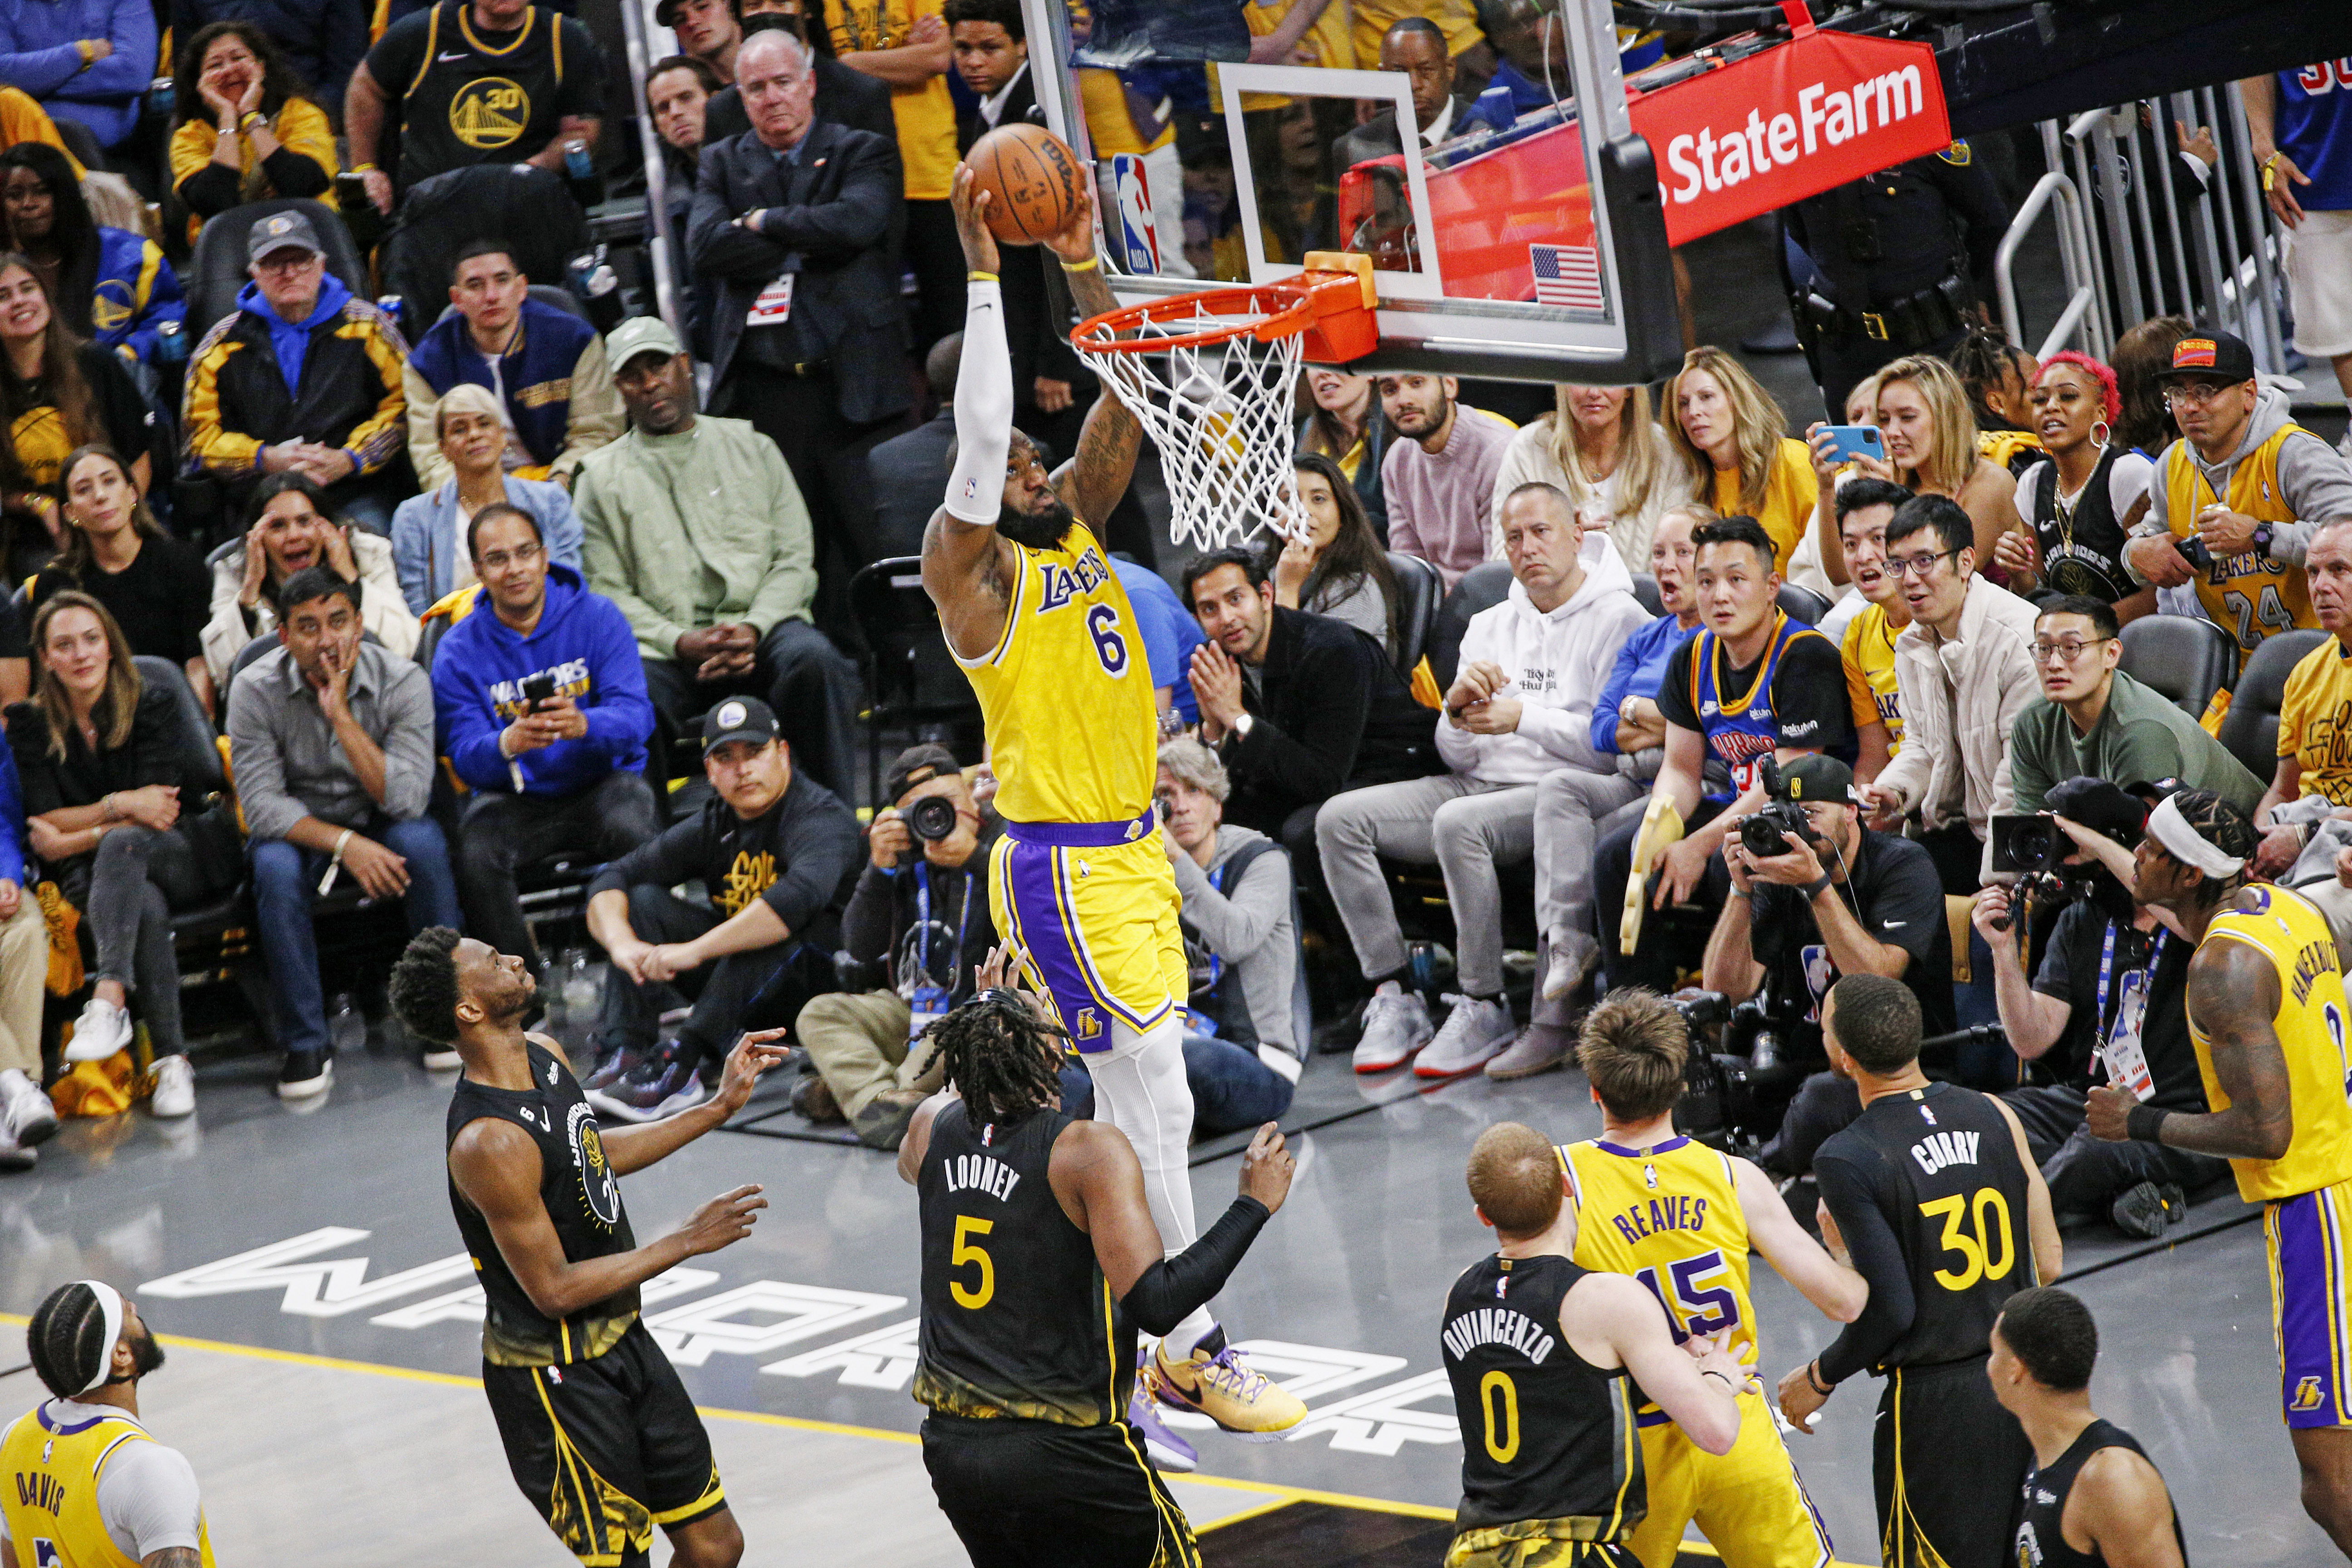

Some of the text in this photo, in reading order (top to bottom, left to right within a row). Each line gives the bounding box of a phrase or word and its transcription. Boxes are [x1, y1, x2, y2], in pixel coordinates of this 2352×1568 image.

[486, 88, 519, 110] 30
[1130, 248, 1150, 270] NBA
[2043, 543, 2112, 573] WARIORS
[1085, 602, 1130, 680] 6
[2223, 583, 2295, 651] 24
[490, 657, 589, 703] WAORS
[519, 1106, 535, 1122] 6
[567, 1102, 595, 1167] WARRIORS
[1910, 1130, 1980, 1176] CURRY
[944, 1154, 1021, 1203] LOONEY
[1612, 1195, 1707, 1245] REAVES
[1918, 1187, 2015, 1291] 30
[950, 1215, 995, 1310] 5
[1635, 1248, 1742, 1346] 15
[1442, 1308, 1555, 1366] DIVINCENZO
[1480, 1370, 1520, 1464] 0
[15, 1471, 65, 1518] DAVIS
